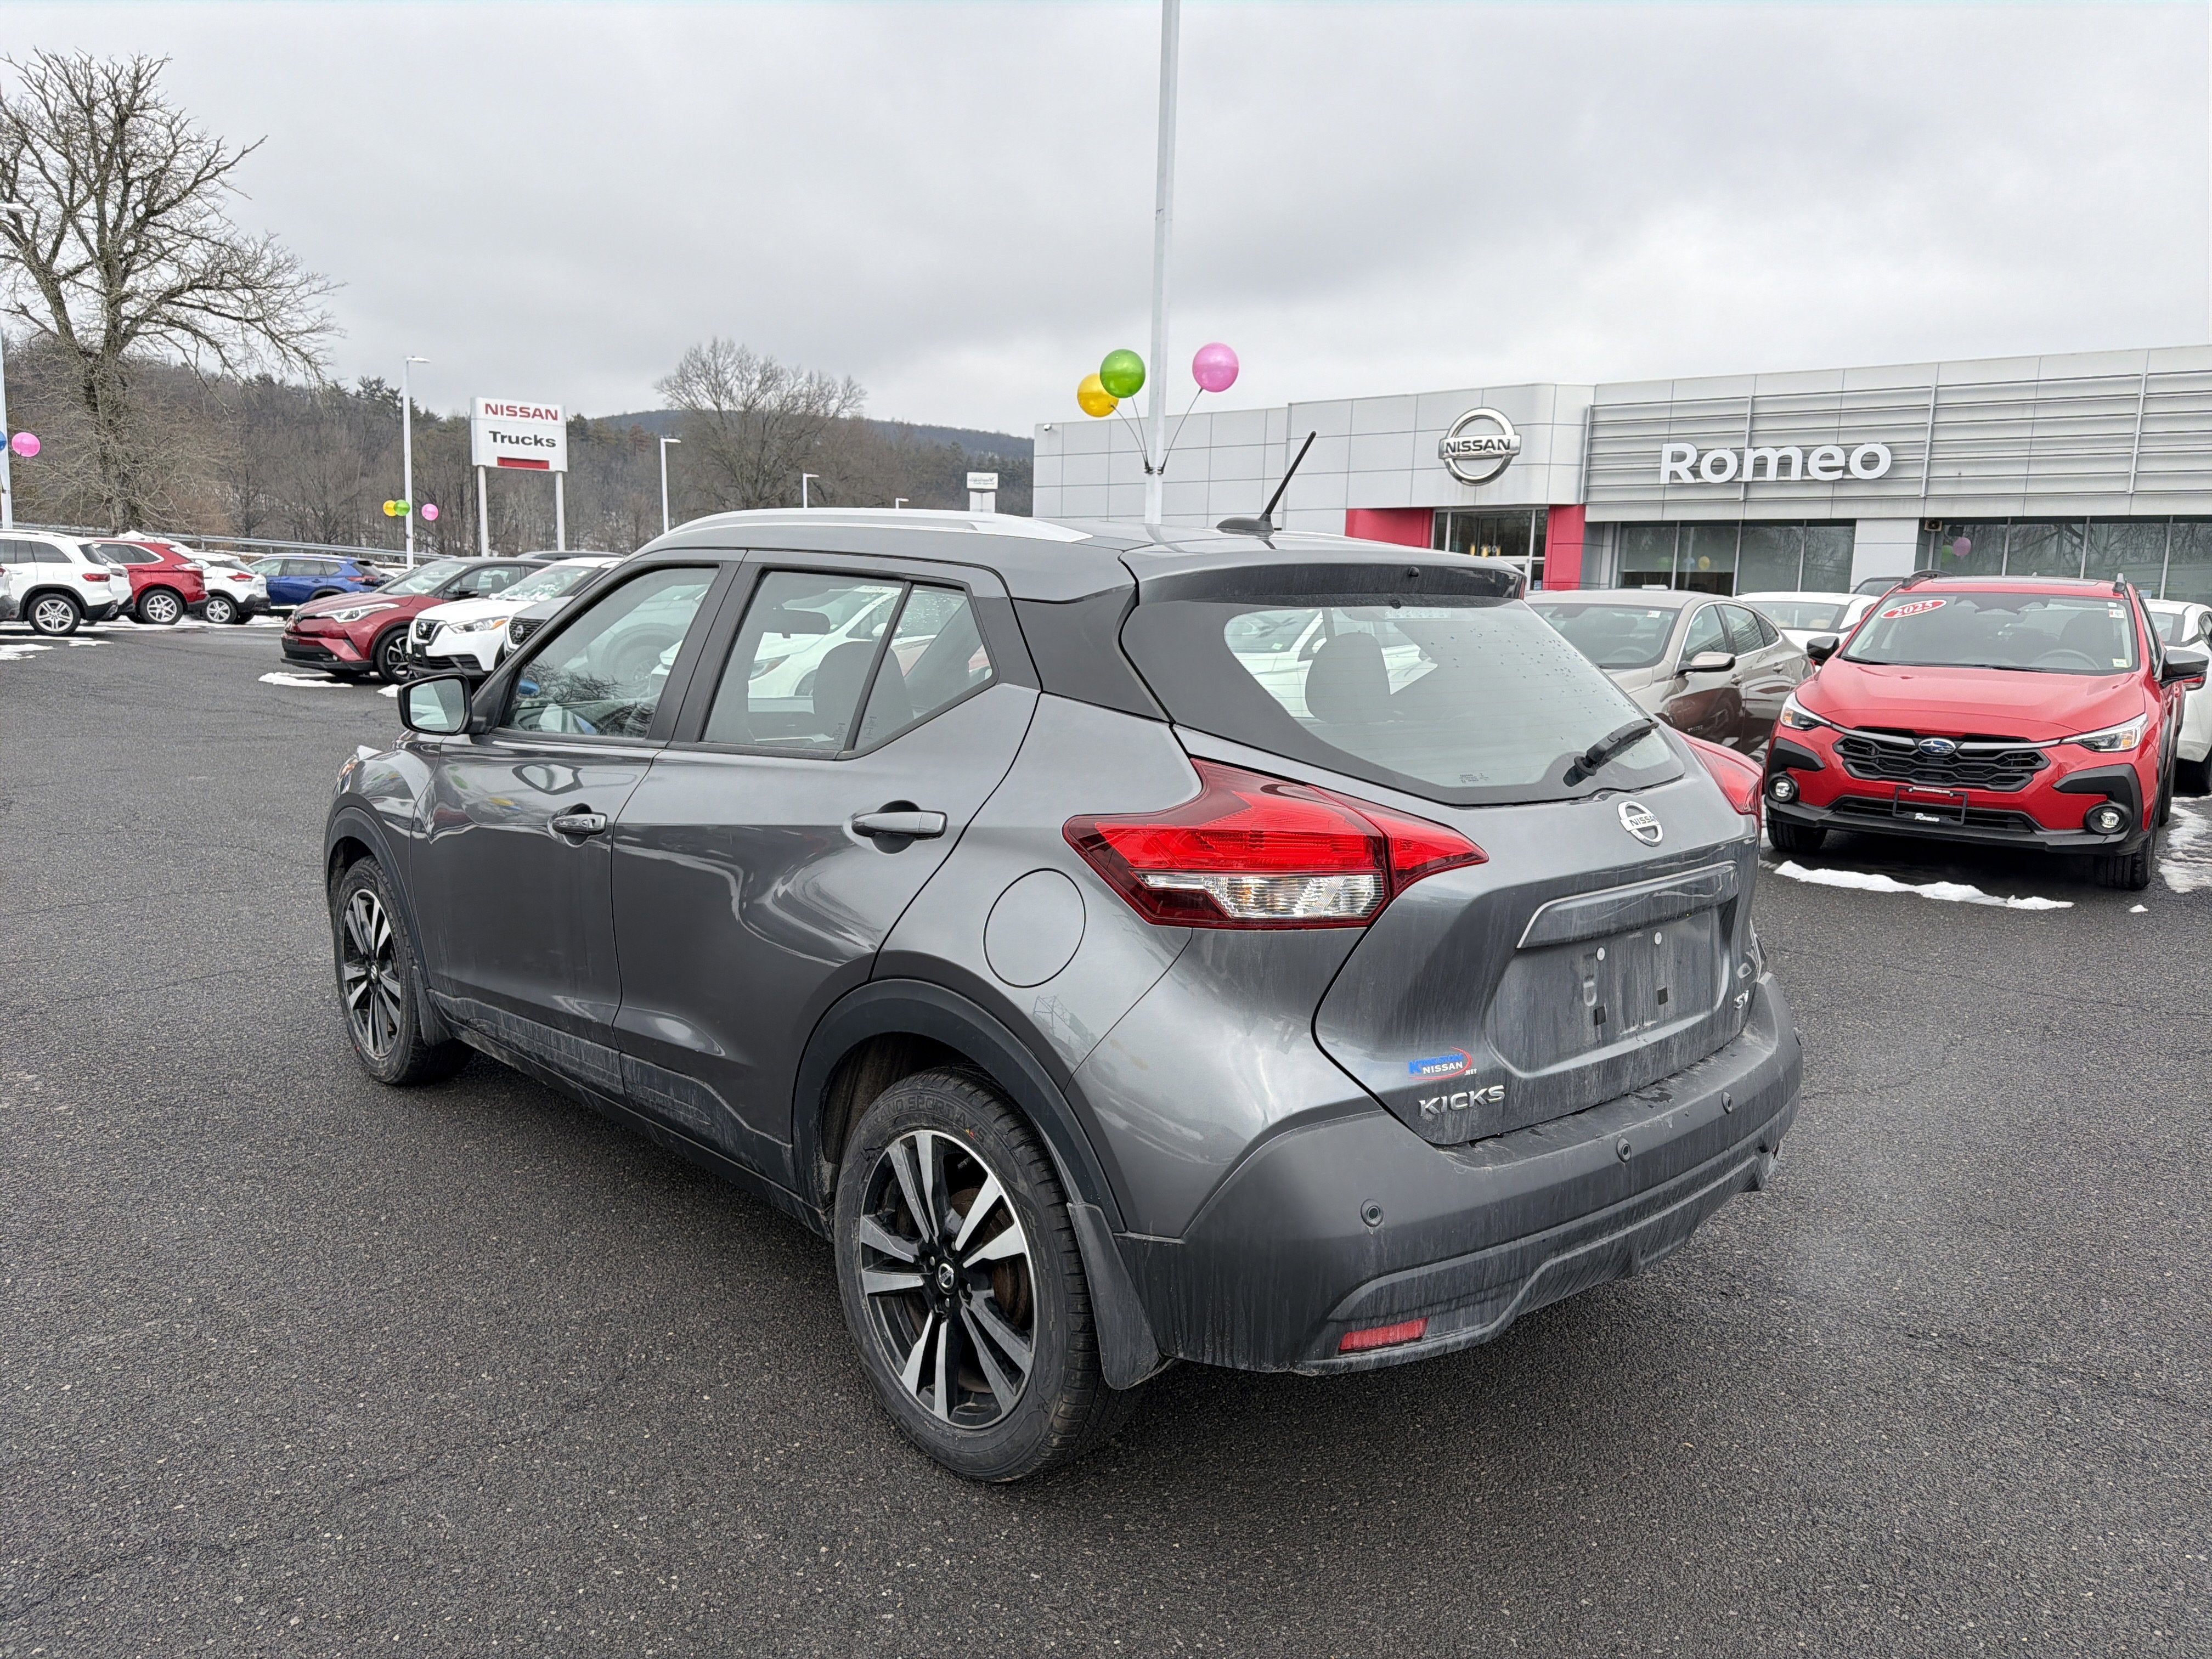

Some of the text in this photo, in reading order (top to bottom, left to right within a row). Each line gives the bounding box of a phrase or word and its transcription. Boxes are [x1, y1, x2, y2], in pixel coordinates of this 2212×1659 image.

[485, 403, 558, 421] NISSAN
[488, 431, 556, 448] Trucks
[1446, 439, 1511, 453] NISSAN
[1659, 442, 1892, 484] Romeo
[1894, 602, 1933, 616] 2025
[1423, 1061, 1463, 1075] NISSAN
[908, 1095, 955, 1116] SPORT
[1418, 1084, 1505, 1117] KICKS
